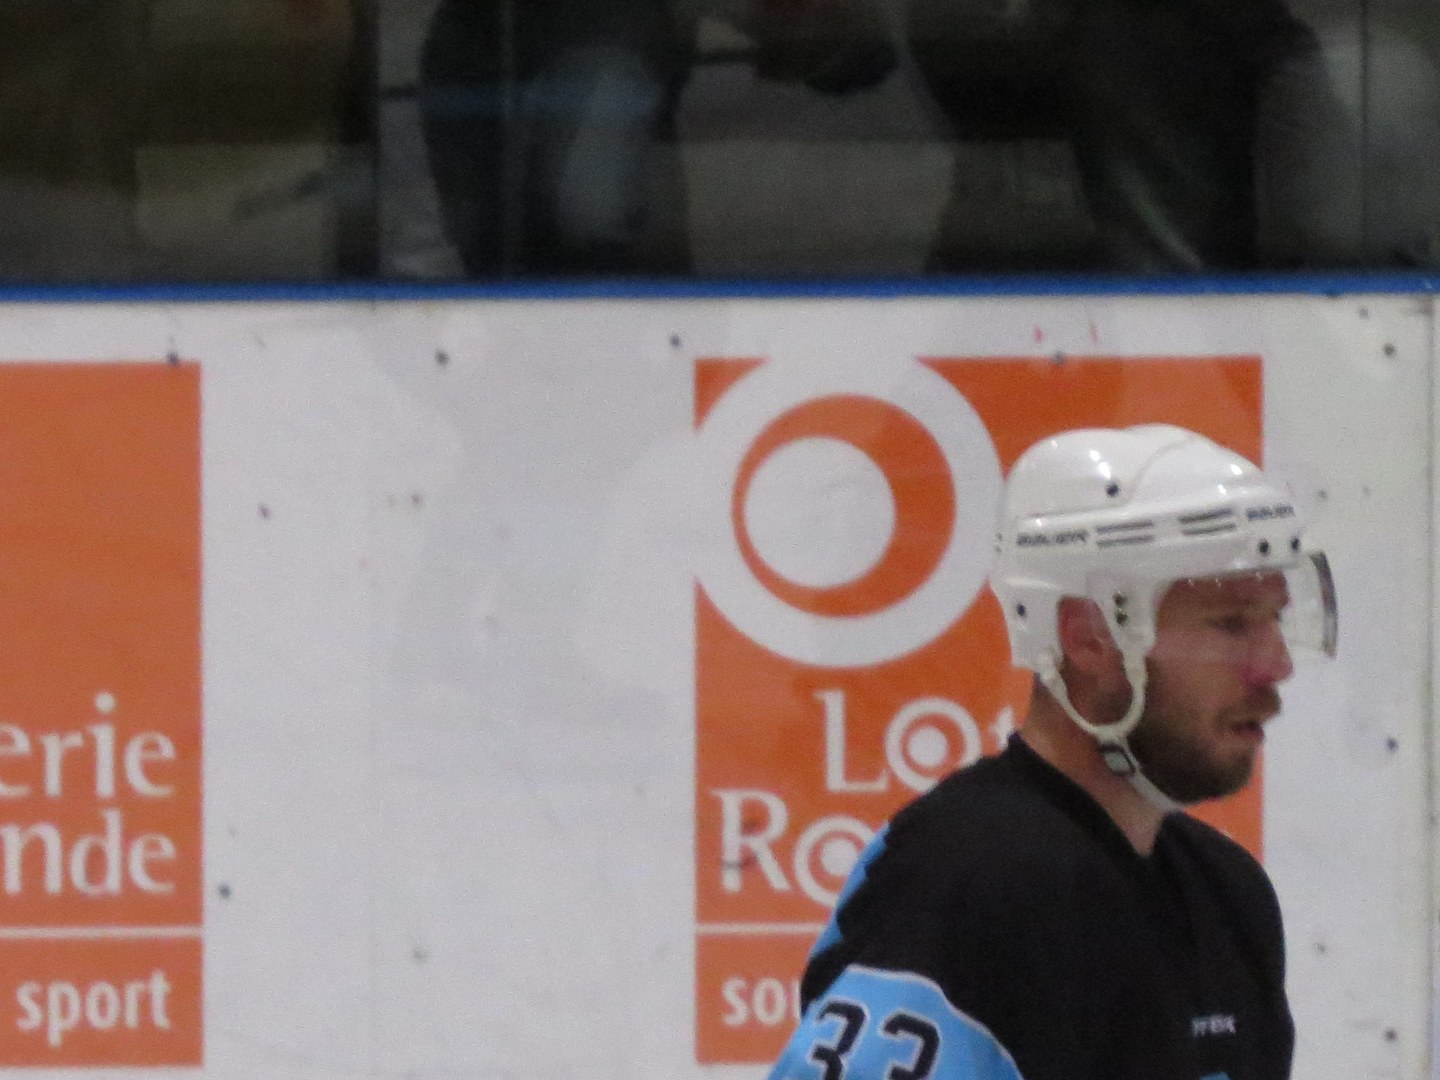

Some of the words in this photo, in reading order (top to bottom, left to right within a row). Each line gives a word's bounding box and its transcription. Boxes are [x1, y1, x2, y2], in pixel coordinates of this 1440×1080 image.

[0, 692, 176, 799] erie
[0, 808, 177, 895] nde
[16, 969, 171, 1047] sport
